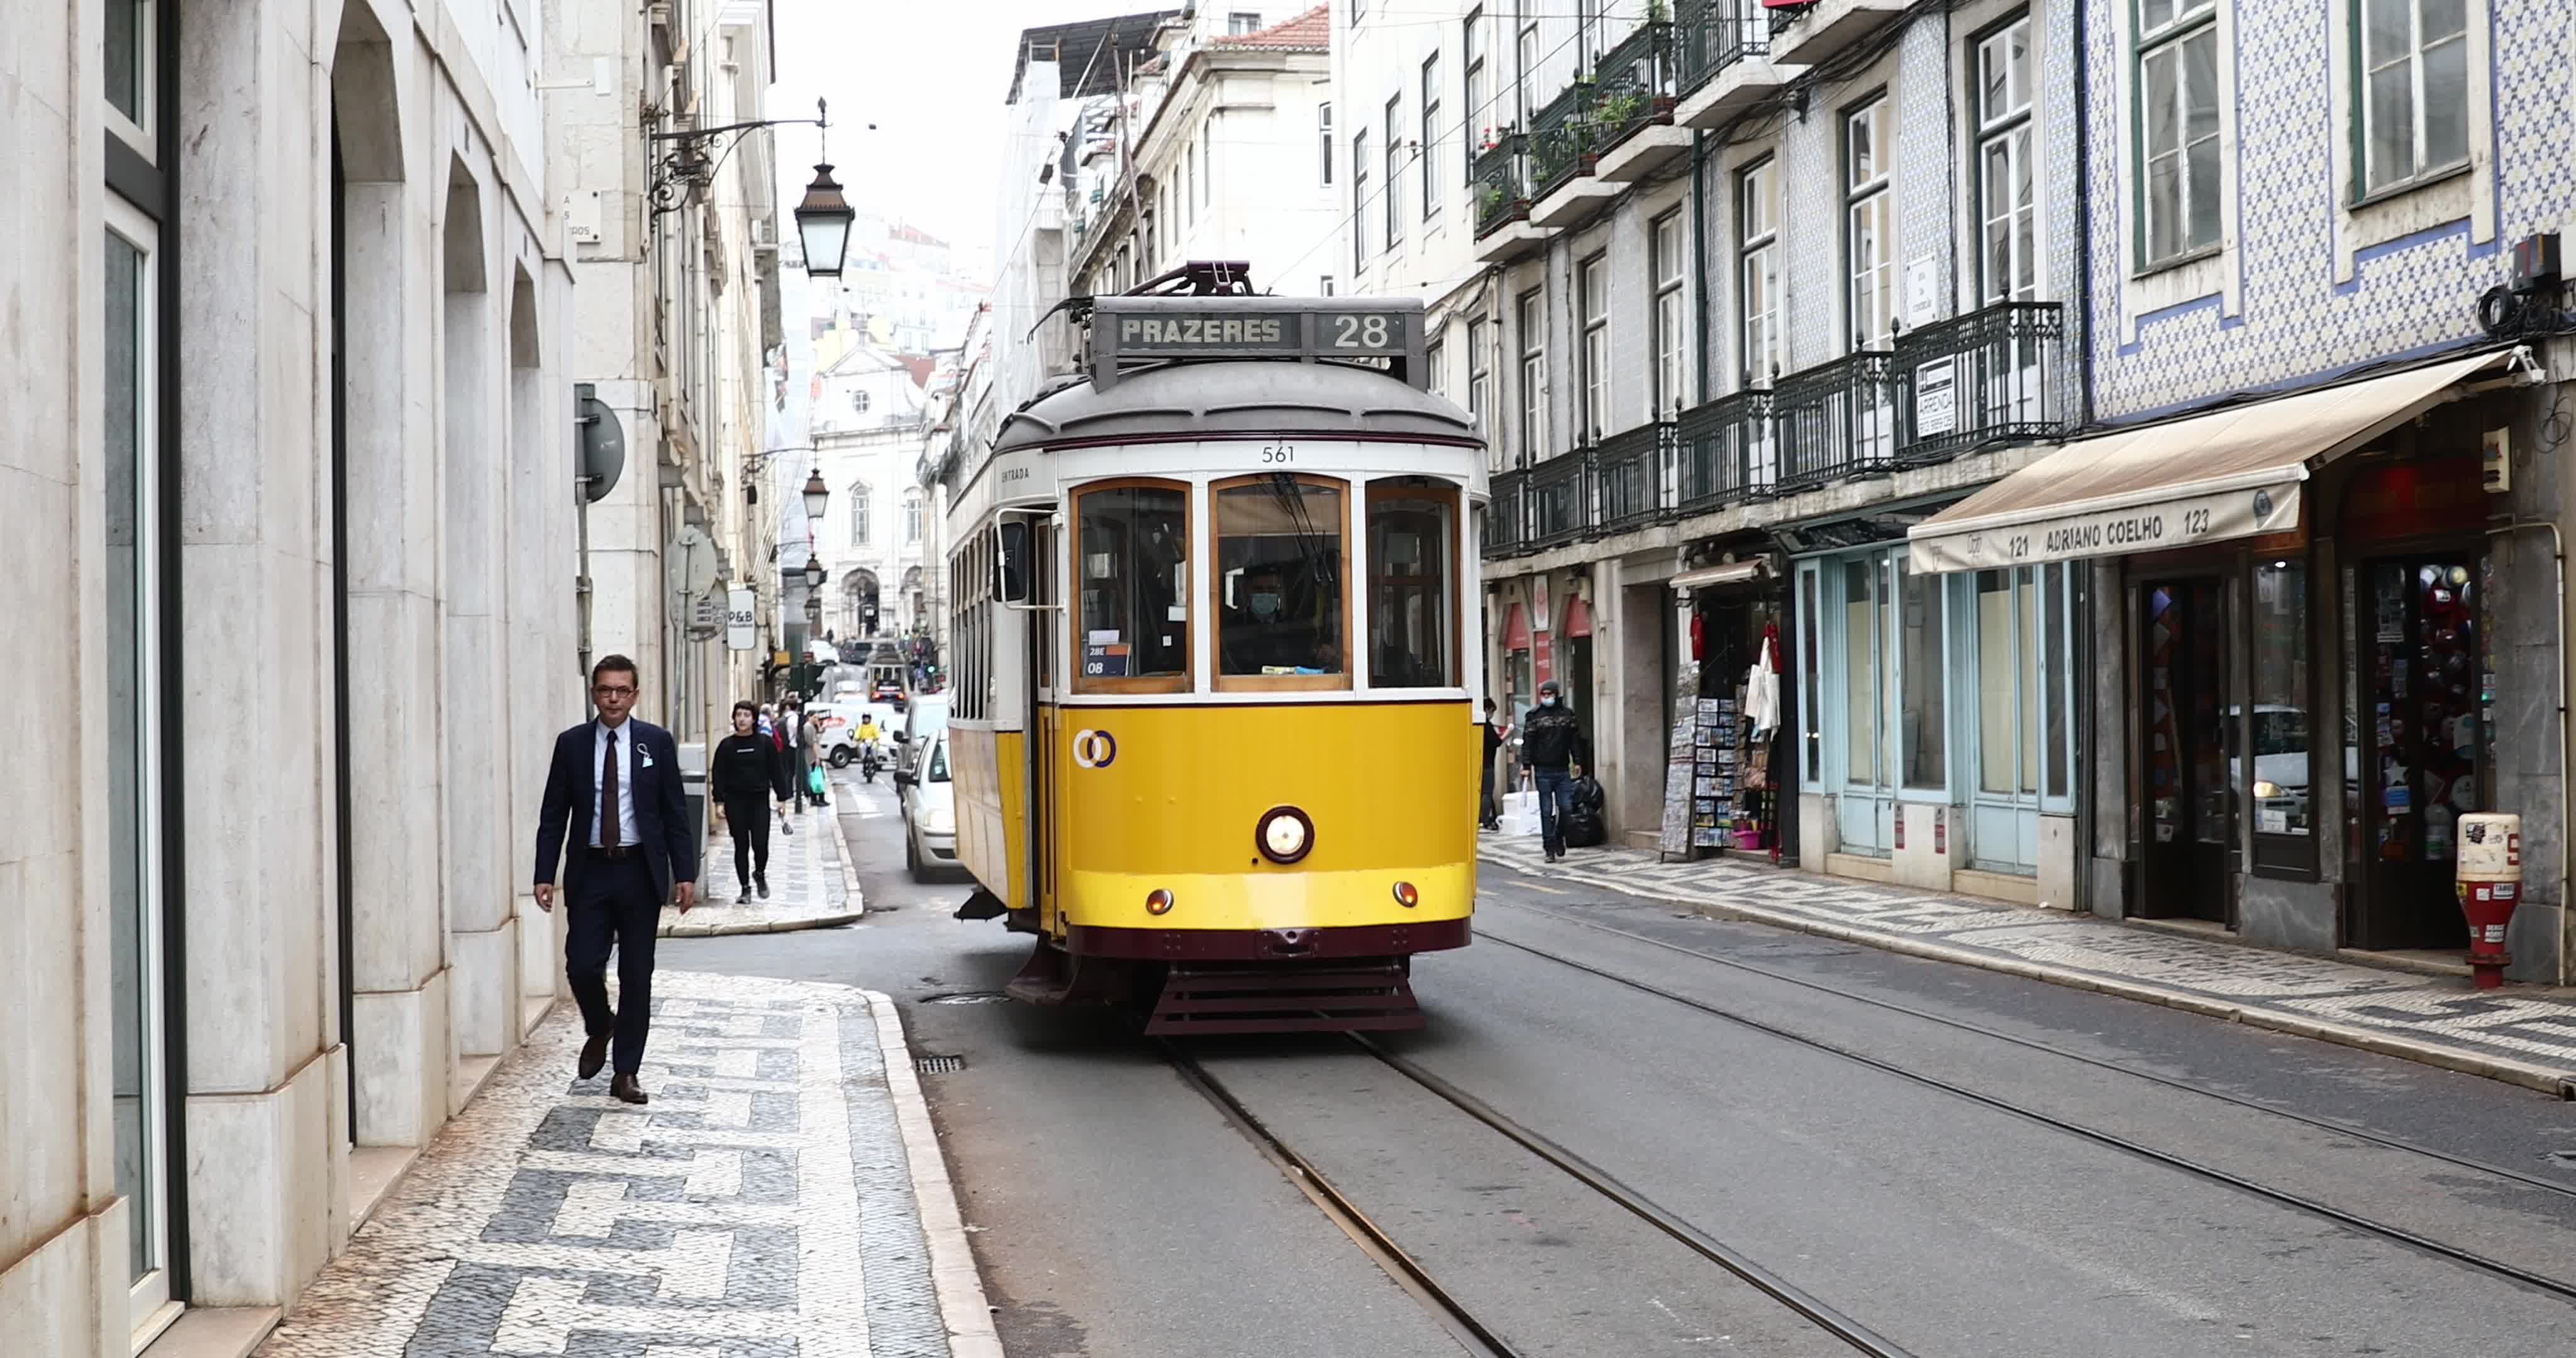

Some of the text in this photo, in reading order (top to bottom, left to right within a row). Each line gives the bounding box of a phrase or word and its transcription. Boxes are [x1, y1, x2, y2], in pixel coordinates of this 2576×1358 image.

[1121, 314, 1389, 348] PRAZERES 28
[1262, 446, 1294, 463] 561
[1002, 467, 1030, 483] ENTRADA
[2009, 534, 2028, 558] 121
[2046, 524, 2102, 552] ADRIANO
[2107, 514, 2163, 546] COELHO
[2184, 508, 2210, 535] 123
[729, 610, 753, 623] P&B
[1087, 662, 1104, 675] 08
